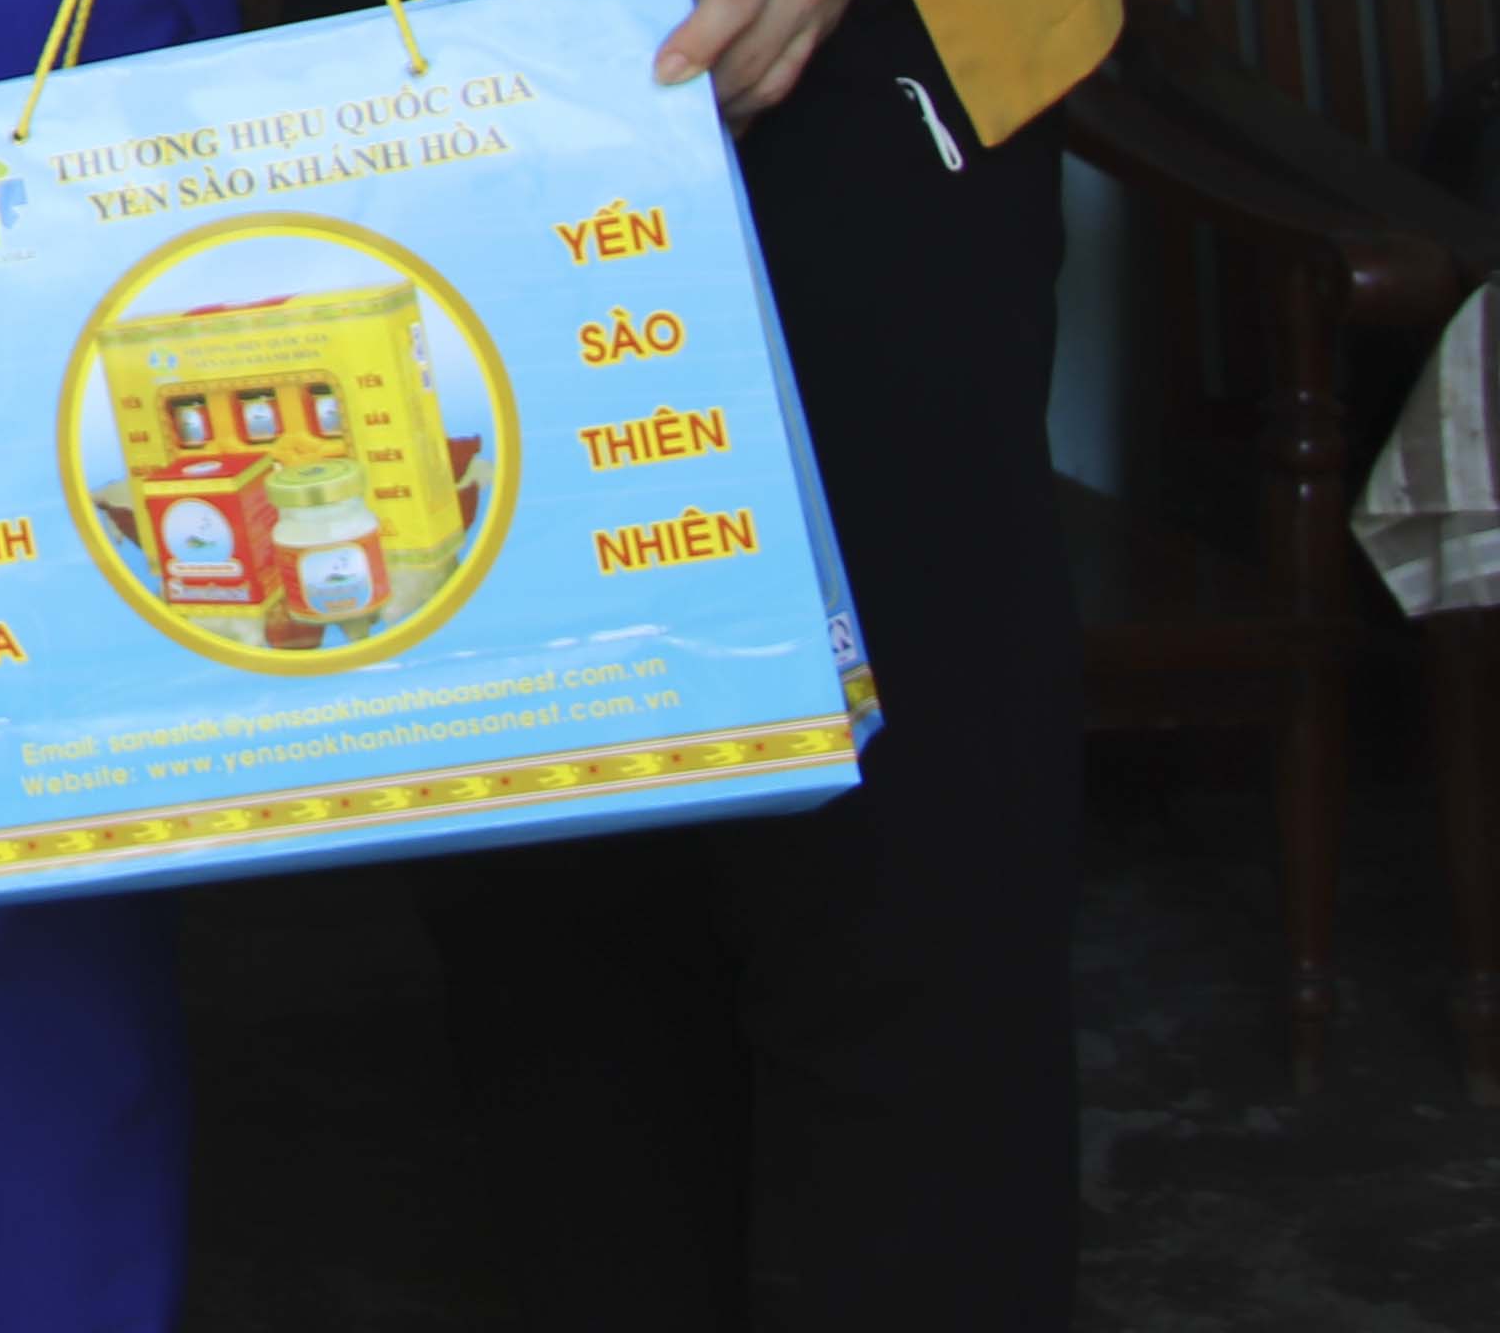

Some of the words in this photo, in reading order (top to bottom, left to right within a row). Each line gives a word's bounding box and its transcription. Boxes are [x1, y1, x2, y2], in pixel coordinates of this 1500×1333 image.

[49, 127, 220, 184] THƯƠNG
[227, 108, 326, 158] HIỆU
[335, 85, 451, 140] QUỐC
[459, 72, 537, 110] GIA
[178, 165, 256, 212] SÀO
[265, 138, 415, 195] KHÁNH
[419, 120, 510, 167] HÒA
[554, 197, 671, 266] YẾN
[577, 305, 685, 367] SÀO
[577, 403, 731, 472] THIÊN
[593, 504, 761, 575] NHIÊN
[19, 763, 139, 797] Website:
[145, 686, 681, 780] www.yensaokhanhhoasanest.com.vn
[19, 729, 101, 767] Email:
